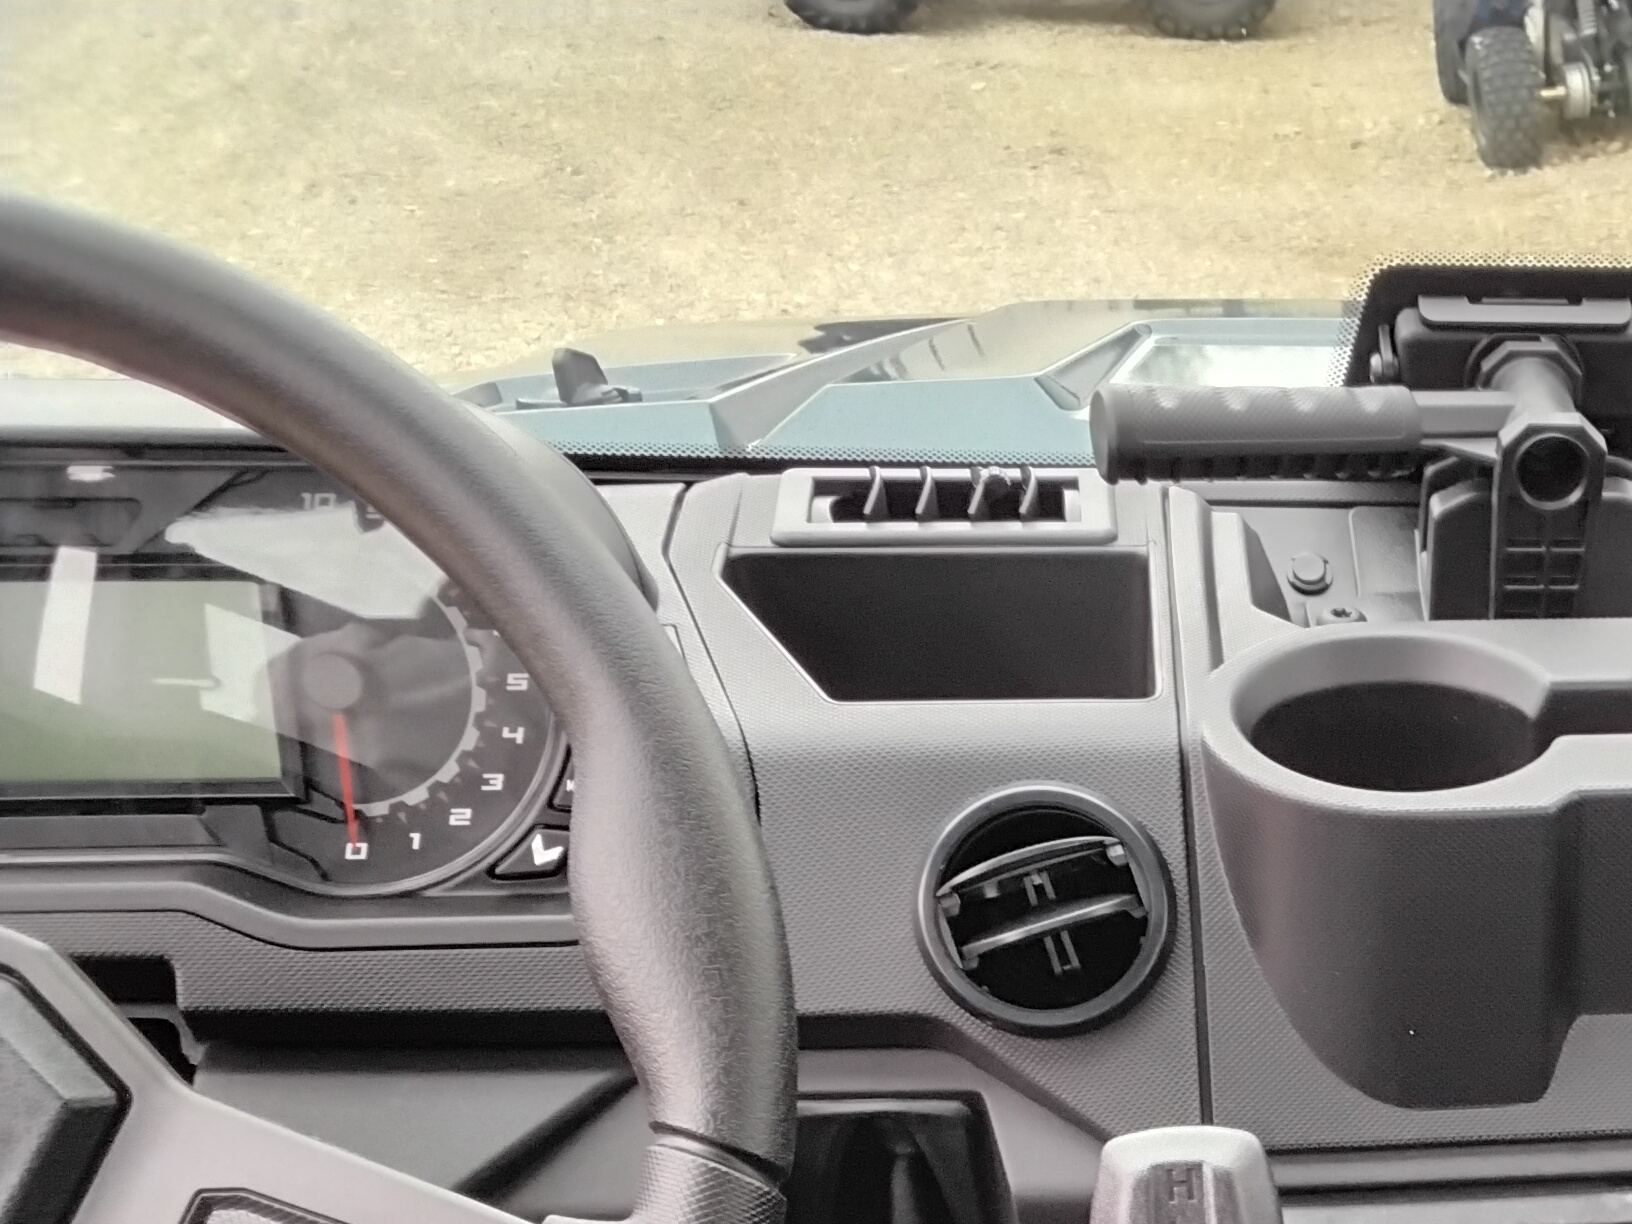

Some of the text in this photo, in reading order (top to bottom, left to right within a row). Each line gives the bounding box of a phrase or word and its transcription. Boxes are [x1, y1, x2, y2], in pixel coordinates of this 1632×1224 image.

[301, 492, 337, 511] 10
[506, 673, 529, 690] 5
[502, 727, 524, 744] 4
[481, 774, 504, 790] 3
[449, 808, 472, 825] 2
[409, 833, 421, 849] 1
[345, 843, 368, 859] 0
[1166, 1168, 1197, 1203] H
